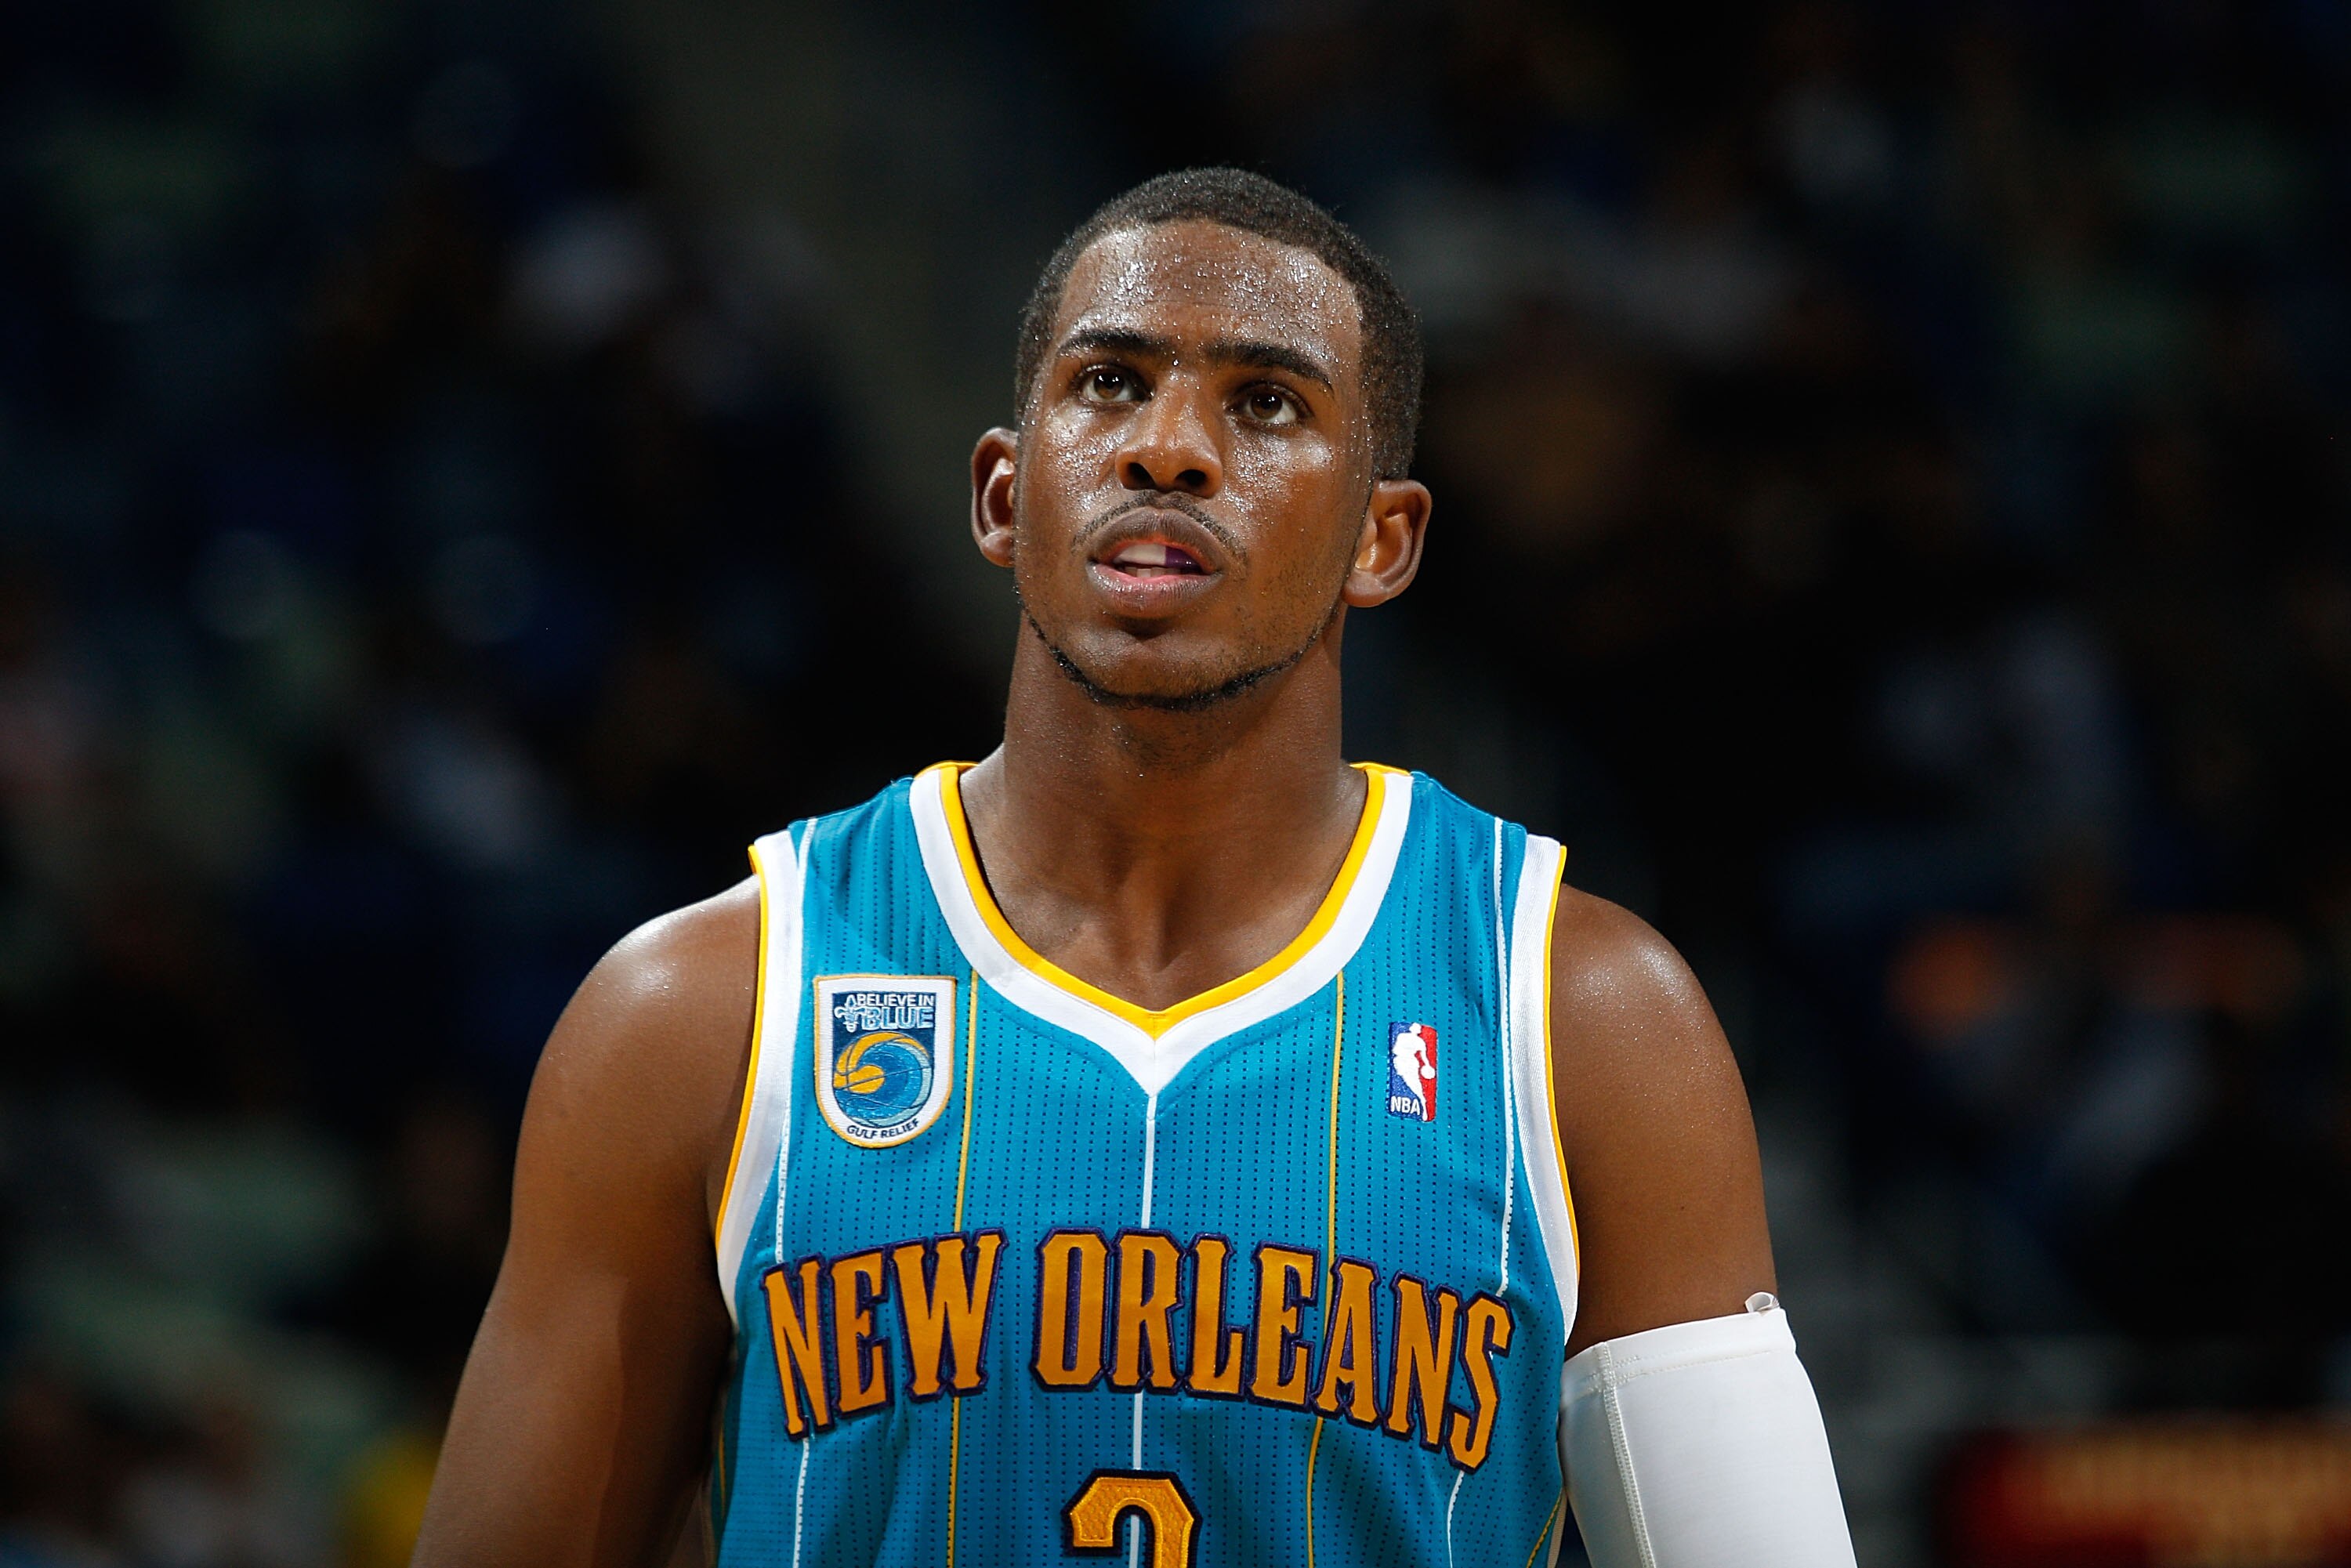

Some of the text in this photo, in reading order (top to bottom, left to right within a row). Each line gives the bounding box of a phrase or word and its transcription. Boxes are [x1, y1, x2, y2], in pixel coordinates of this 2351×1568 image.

[857, 994, 934, 1007] BELIEVE IN
[861, 1006, 934, 1030] BLUE
[1390, 1095, 1421, 1115] NBA
[846, 1118, 919, 1139] GULF RELIEF
[759, 1226, 1515, 1472] NEW ORLEANS
